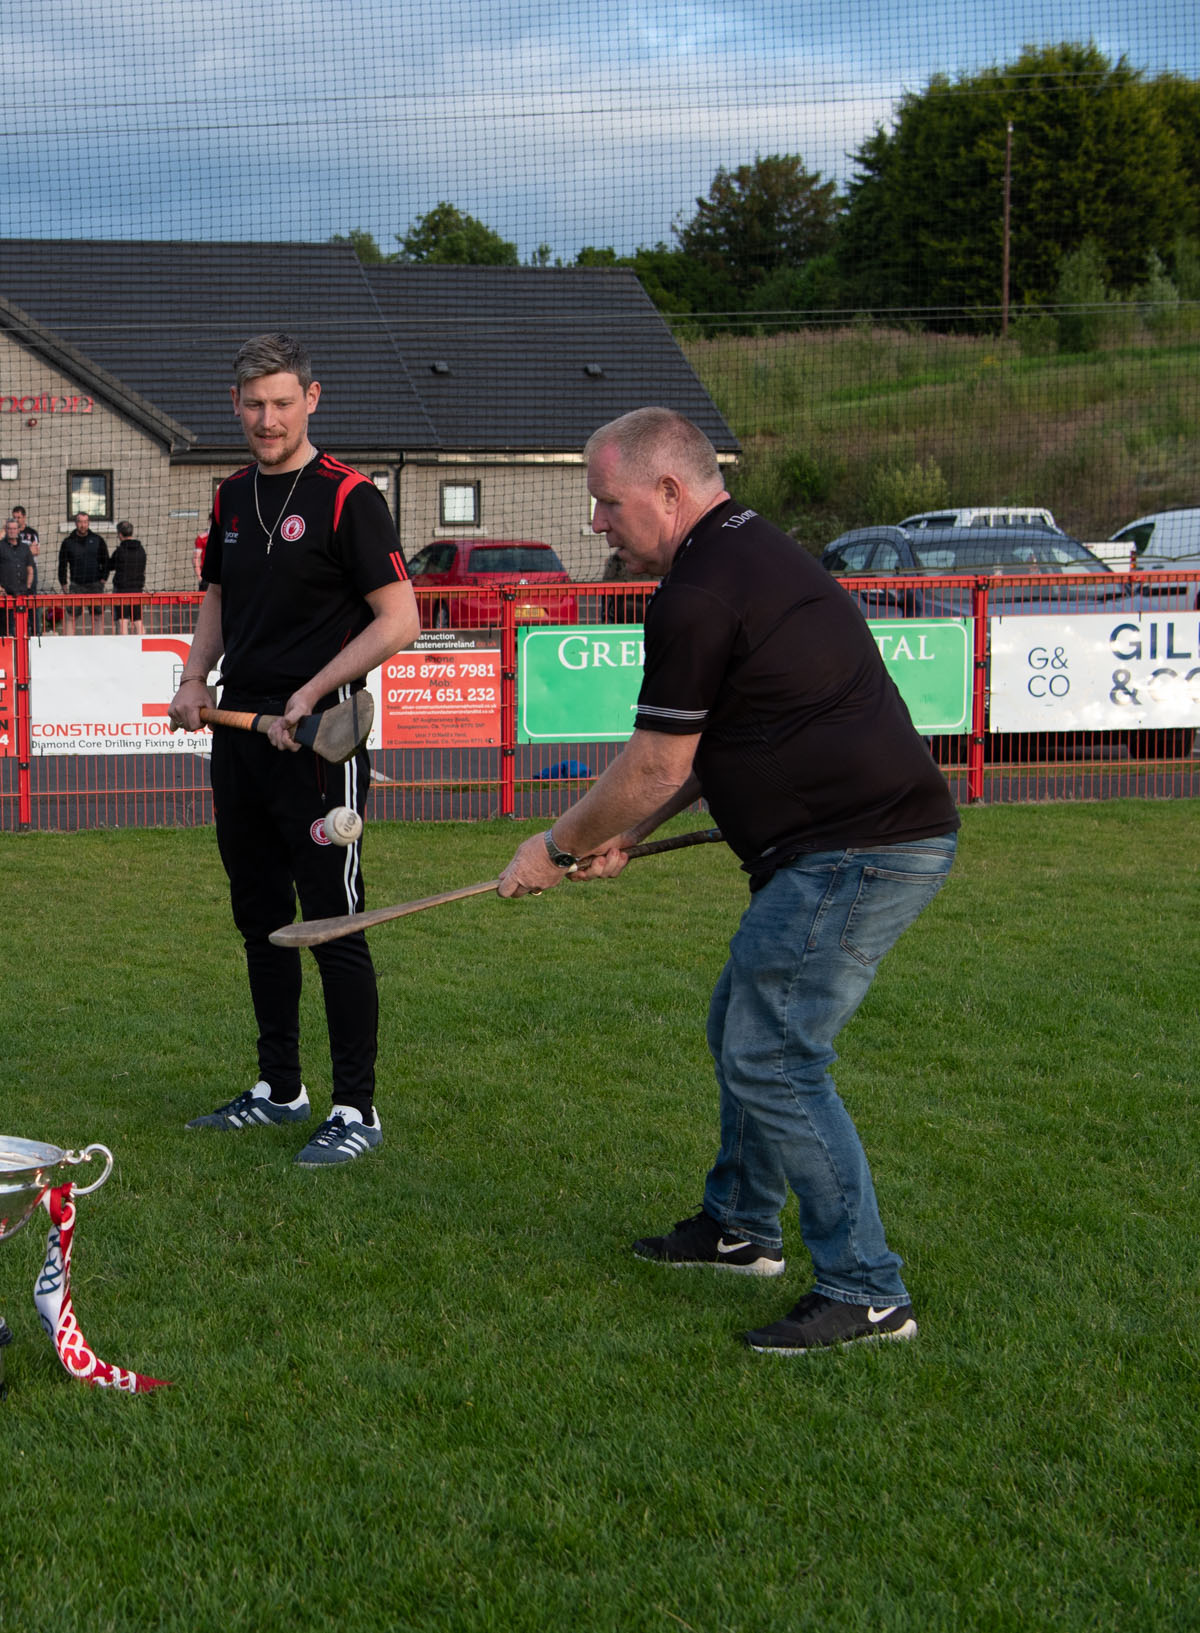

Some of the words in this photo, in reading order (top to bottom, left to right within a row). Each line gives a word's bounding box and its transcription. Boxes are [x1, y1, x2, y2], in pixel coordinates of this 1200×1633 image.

[418, 632, 455, 640] struction
[1109, 621, 1200, 661] GIL
[1028, 646, 1069, 670] G&
[387, 665, 416, 679] 028
[419, 664, 456, 678] 8776
[459, 663, 496, 677] 7981
[1028, 674, 1070, 698] CO
[388, 689, 433, 703] 07774
[436, 688, 464, 702] 651
[467, 687, 495, 701] 232
[32, 740, 76, 750] Diamond
[78, 739, 103, 748] Core
[105, 738, 143, 750] Drilling
[145, 738, 175, 749] Fixing
[177, 738, 185, 747] &
